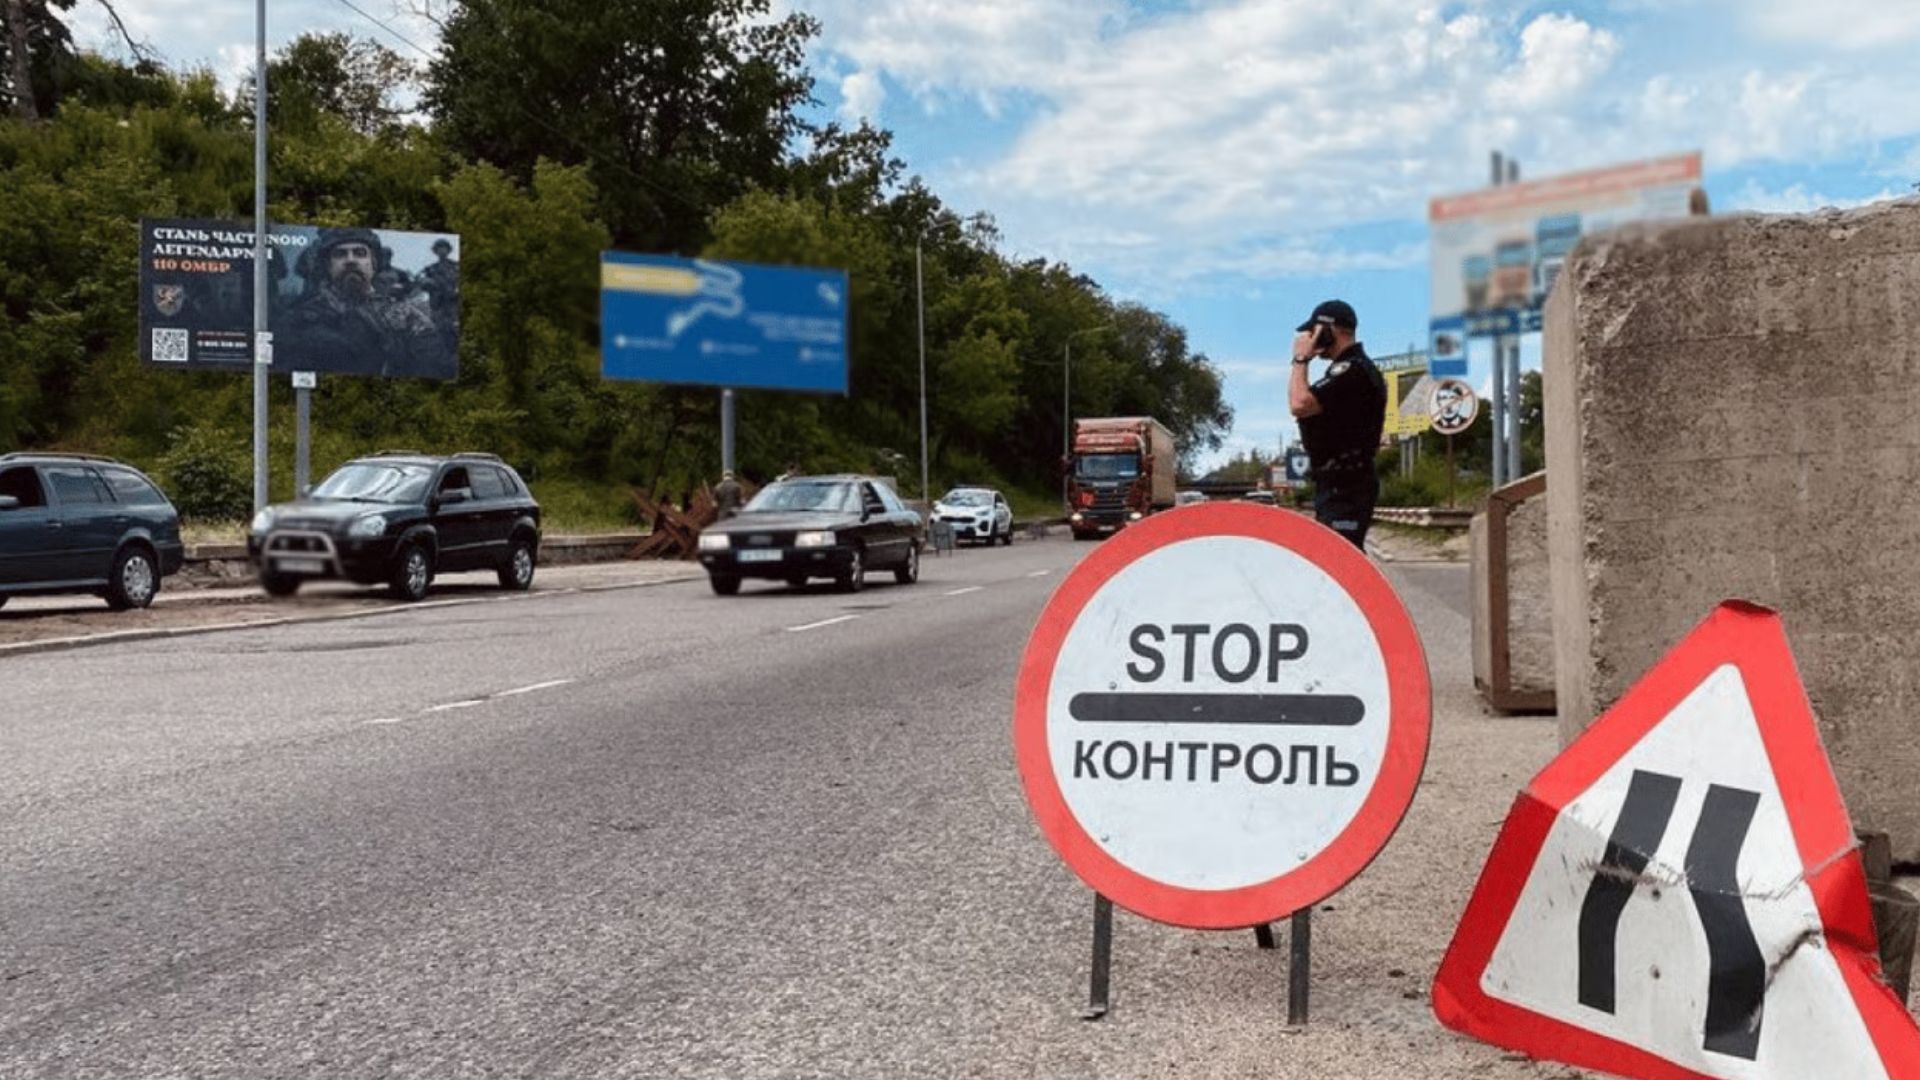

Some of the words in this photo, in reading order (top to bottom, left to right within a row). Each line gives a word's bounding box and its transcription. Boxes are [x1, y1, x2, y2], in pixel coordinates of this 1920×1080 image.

[211, 230, 308, 246] ЧАСТНОЮ
[153, 259, 177, 271] 110
[1126, 623, 1310, 683] STOP
[1073, 740, 1360, 787] КОНТРОЛЬ
